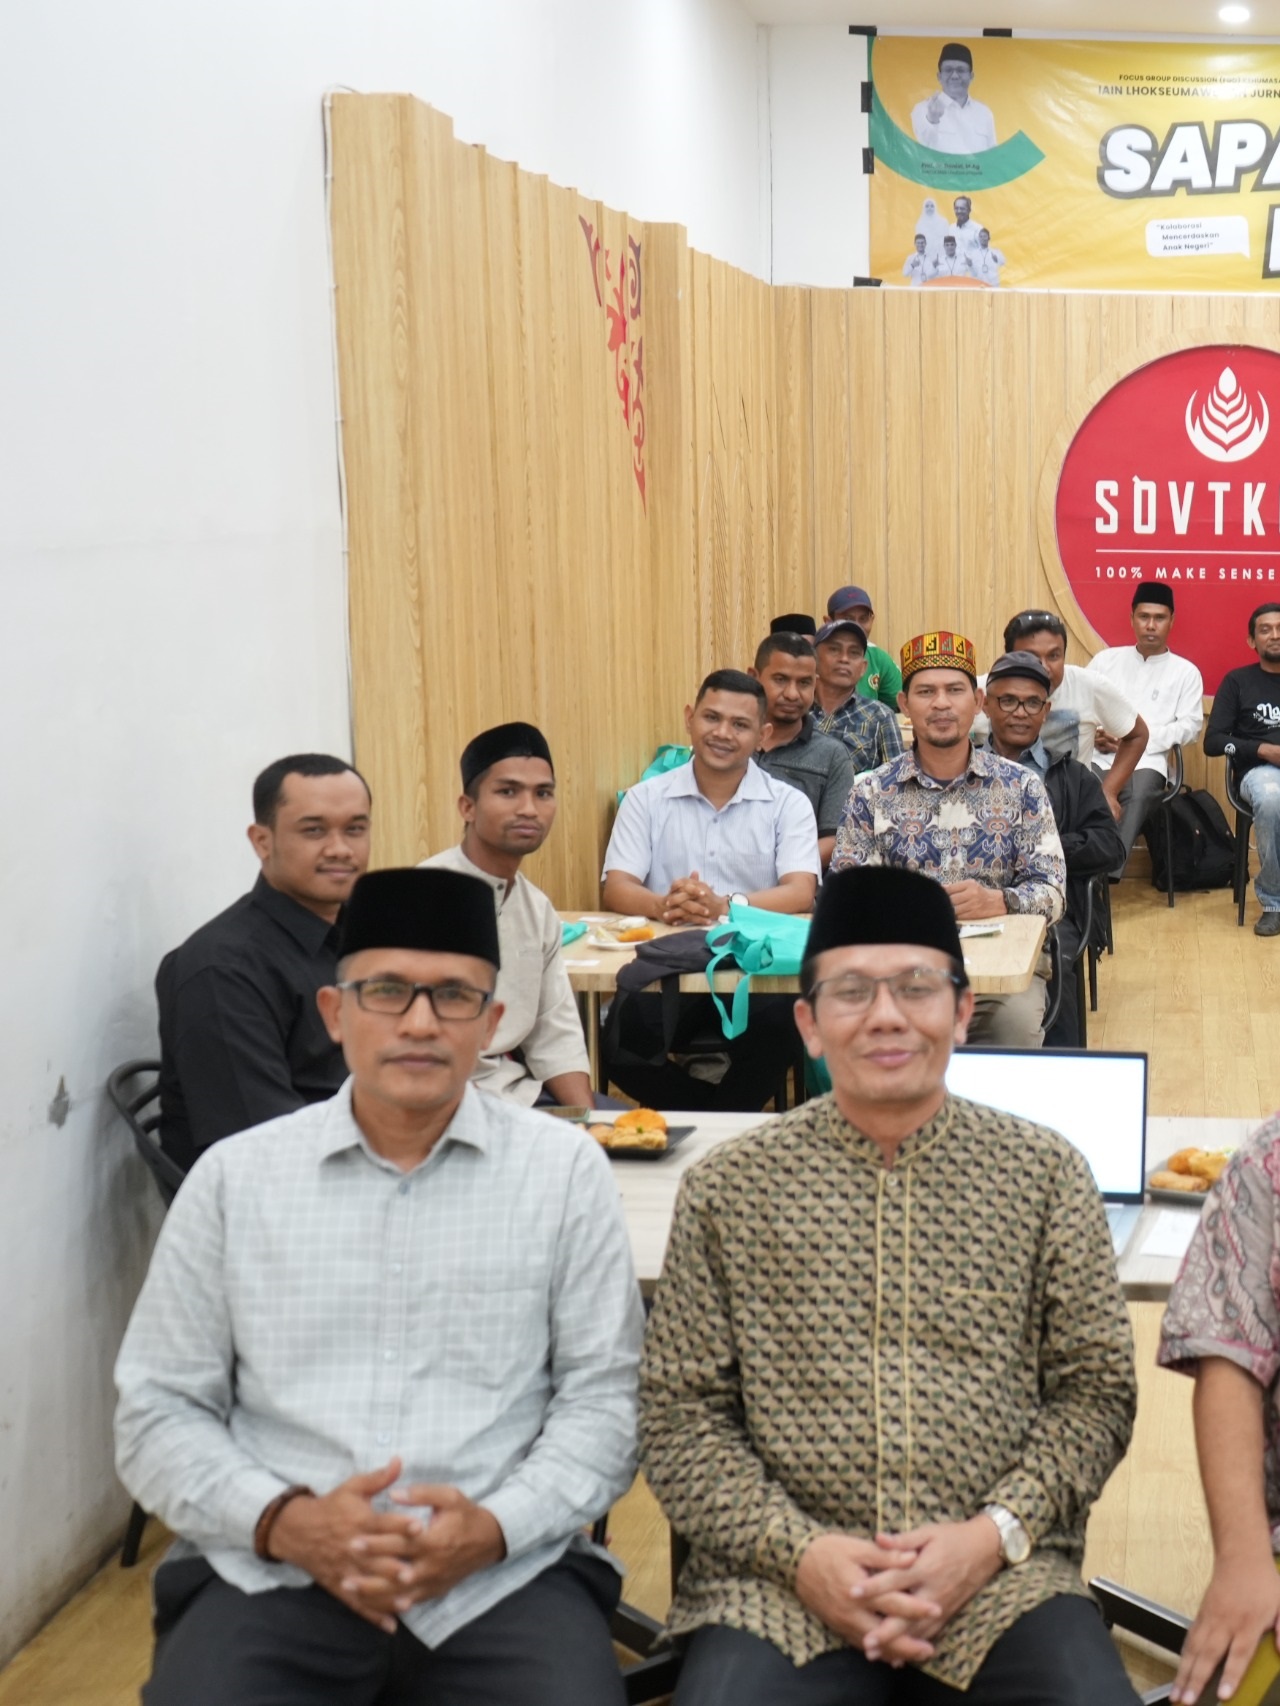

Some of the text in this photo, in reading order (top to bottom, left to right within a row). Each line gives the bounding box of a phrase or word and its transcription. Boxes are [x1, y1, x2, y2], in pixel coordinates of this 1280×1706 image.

[1098, 85, 1123, 96] IAIN
[1162, 232, 1220, 241] Mencerdaskan
[1163, 243, 1183, 251] Anak
[1095, 566, 1142, 579] 100%
[1155, 567, 1207, 580] MAKE
[1218, 568, 1275, 580] SENSE
